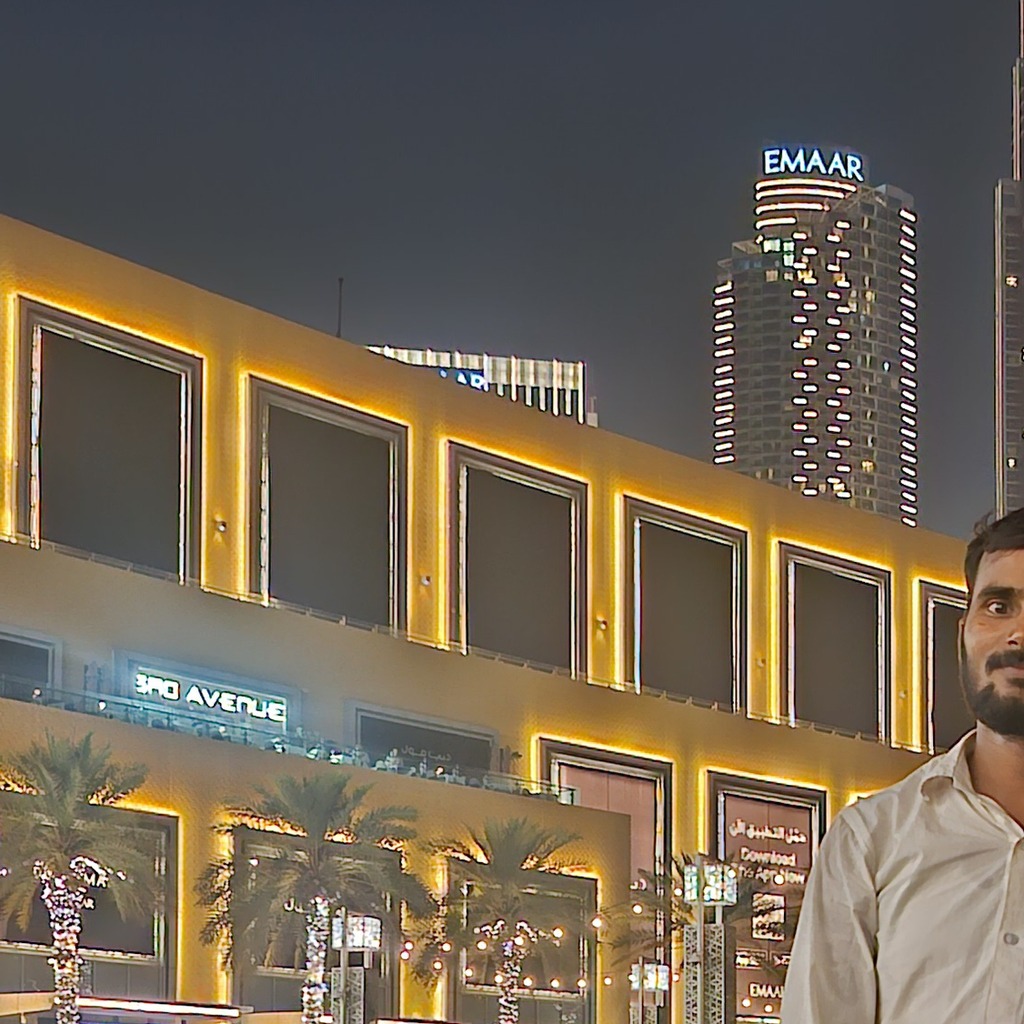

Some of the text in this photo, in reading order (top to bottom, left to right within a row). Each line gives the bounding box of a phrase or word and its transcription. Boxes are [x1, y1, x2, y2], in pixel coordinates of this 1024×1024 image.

[763, 148, 864, 182] EMAAR
[135, 673, 287, 722] 3RD AVENUE
[740, 846, 797, 867] Download
[749, 983, 784, 998] EMAA
